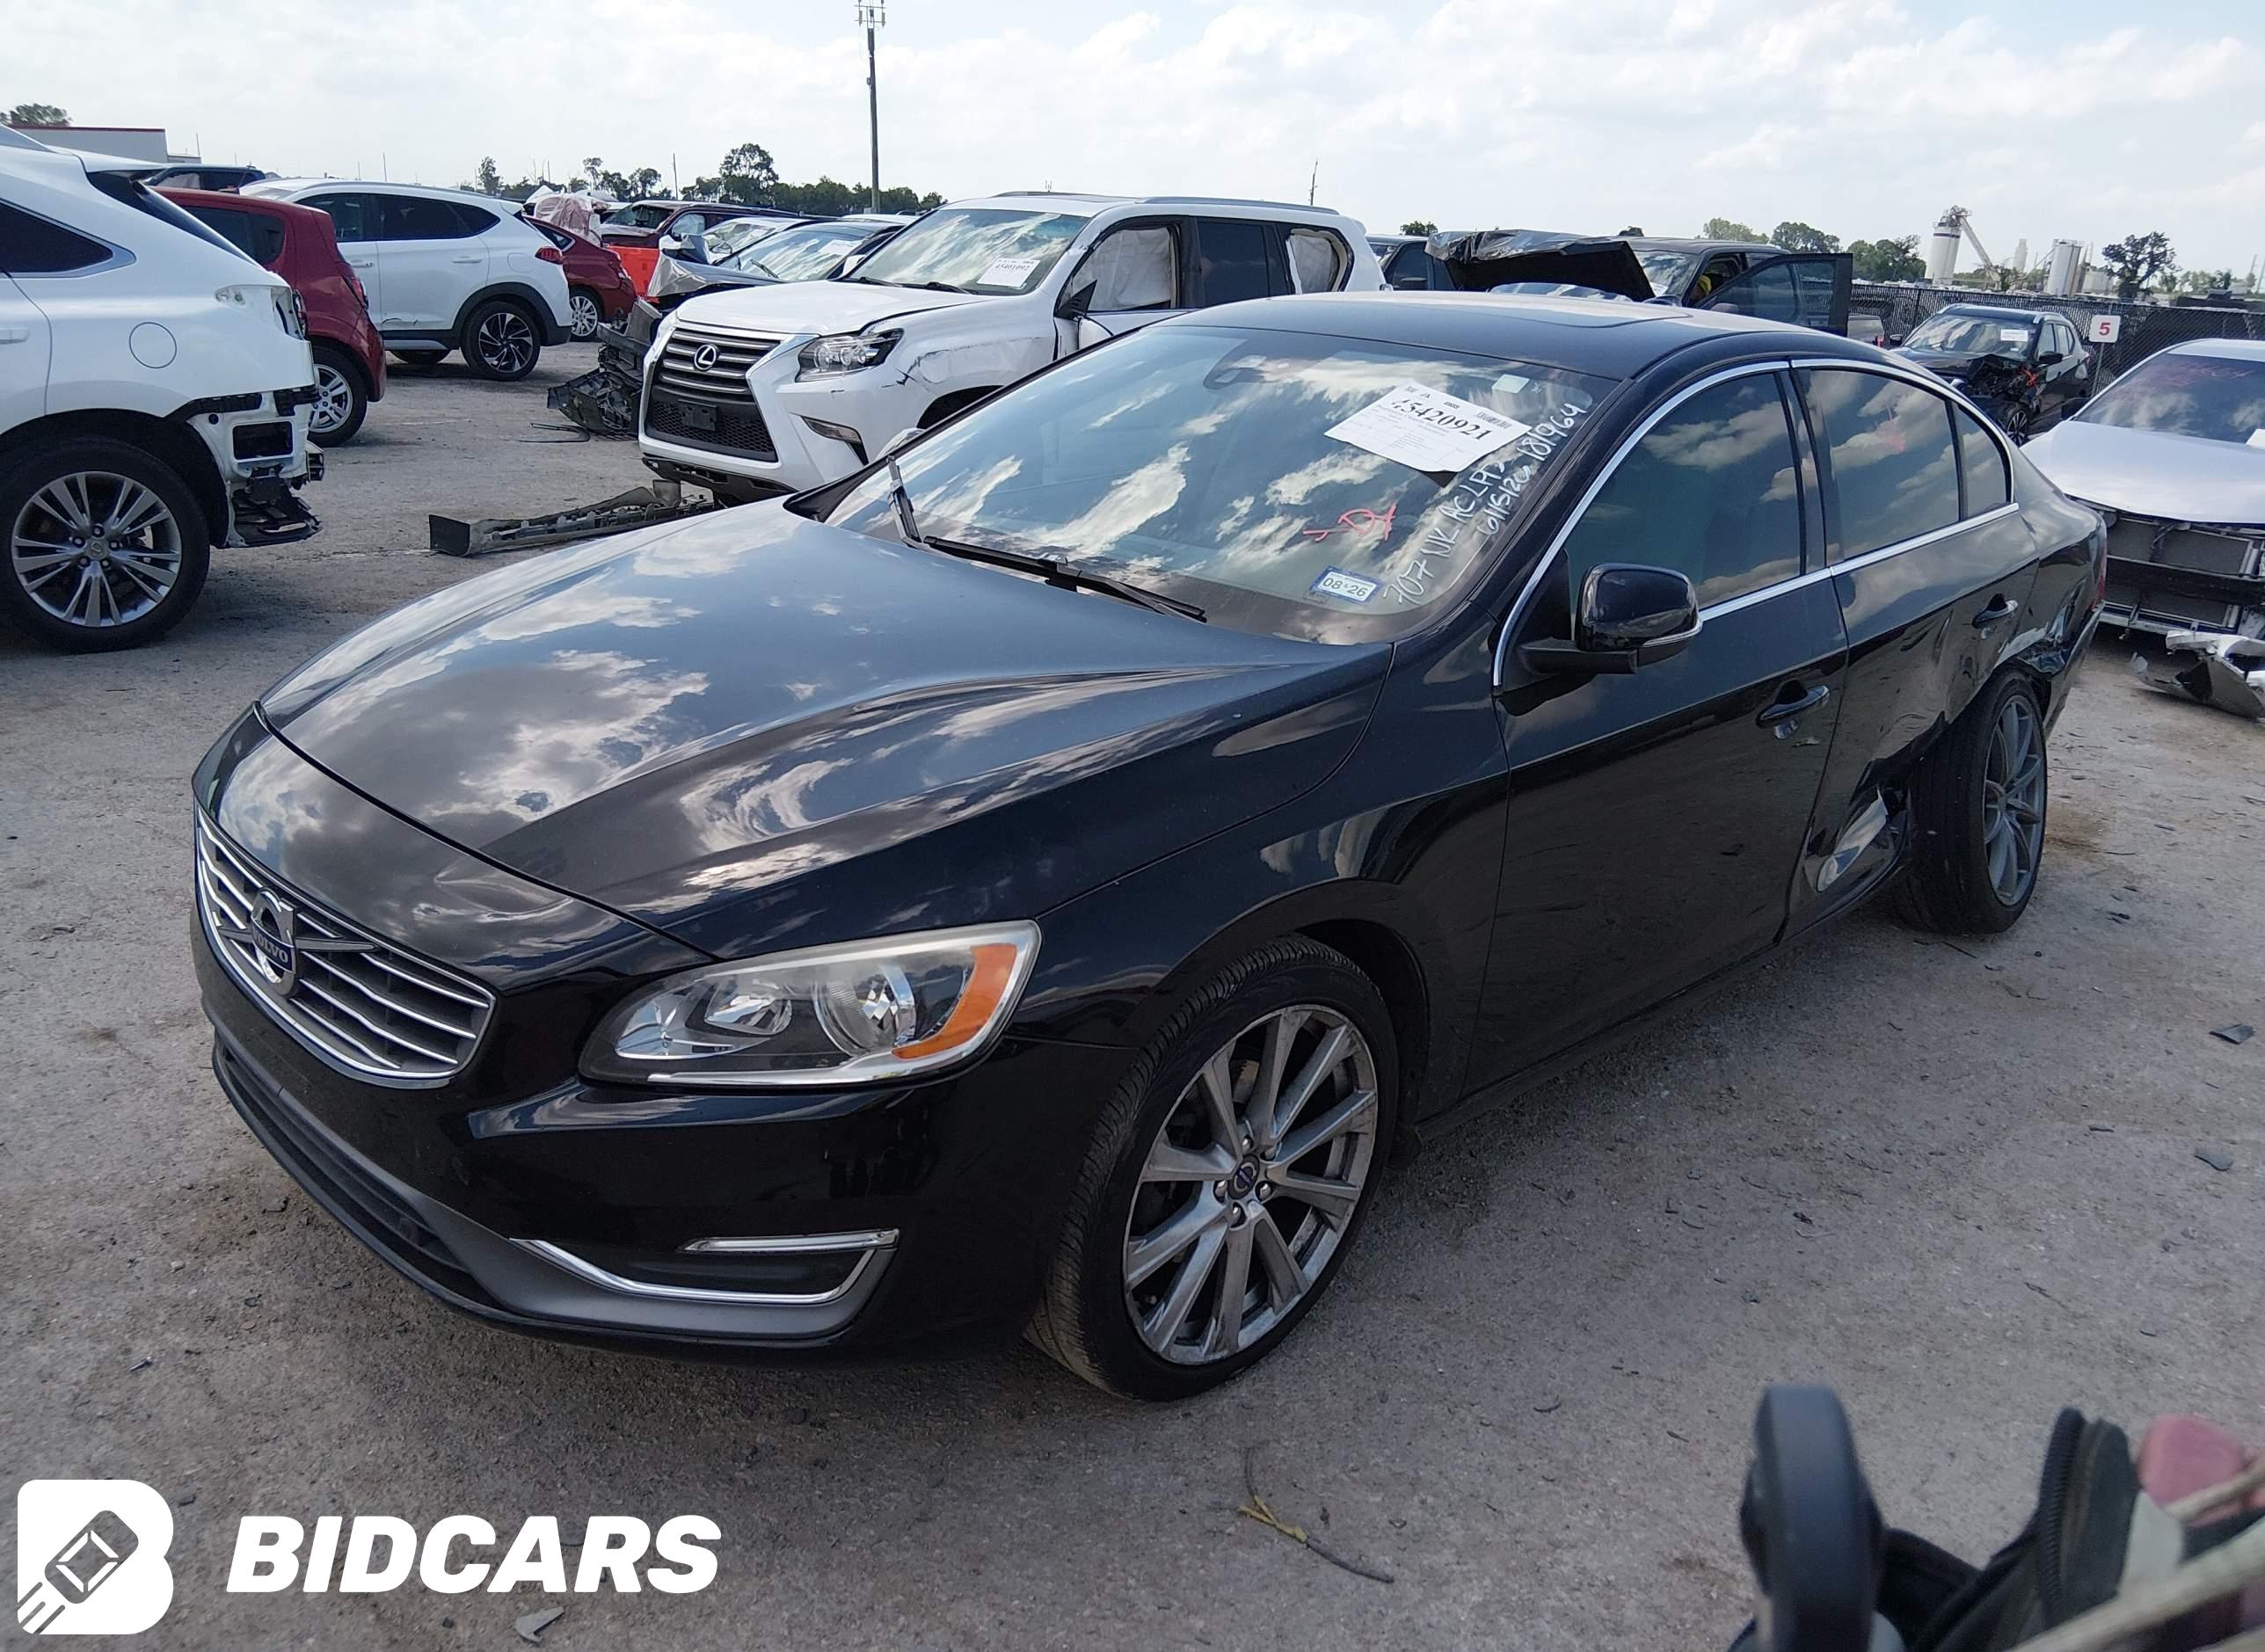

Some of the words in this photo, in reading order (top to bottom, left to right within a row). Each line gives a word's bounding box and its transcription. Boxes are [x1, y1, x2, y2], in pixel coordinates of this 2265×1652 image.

[2099, 322, 2110, 336] 5
[1517, 403, 1588, 461] 181964
[1383, 559, 1434, 604] 707
[1438, 496, 1475, 524] AC
[1322, 578, 1343, 589] 08
[1346, 585, 1368, 596] 26
[253, 929, 288, 963] VOLVO
